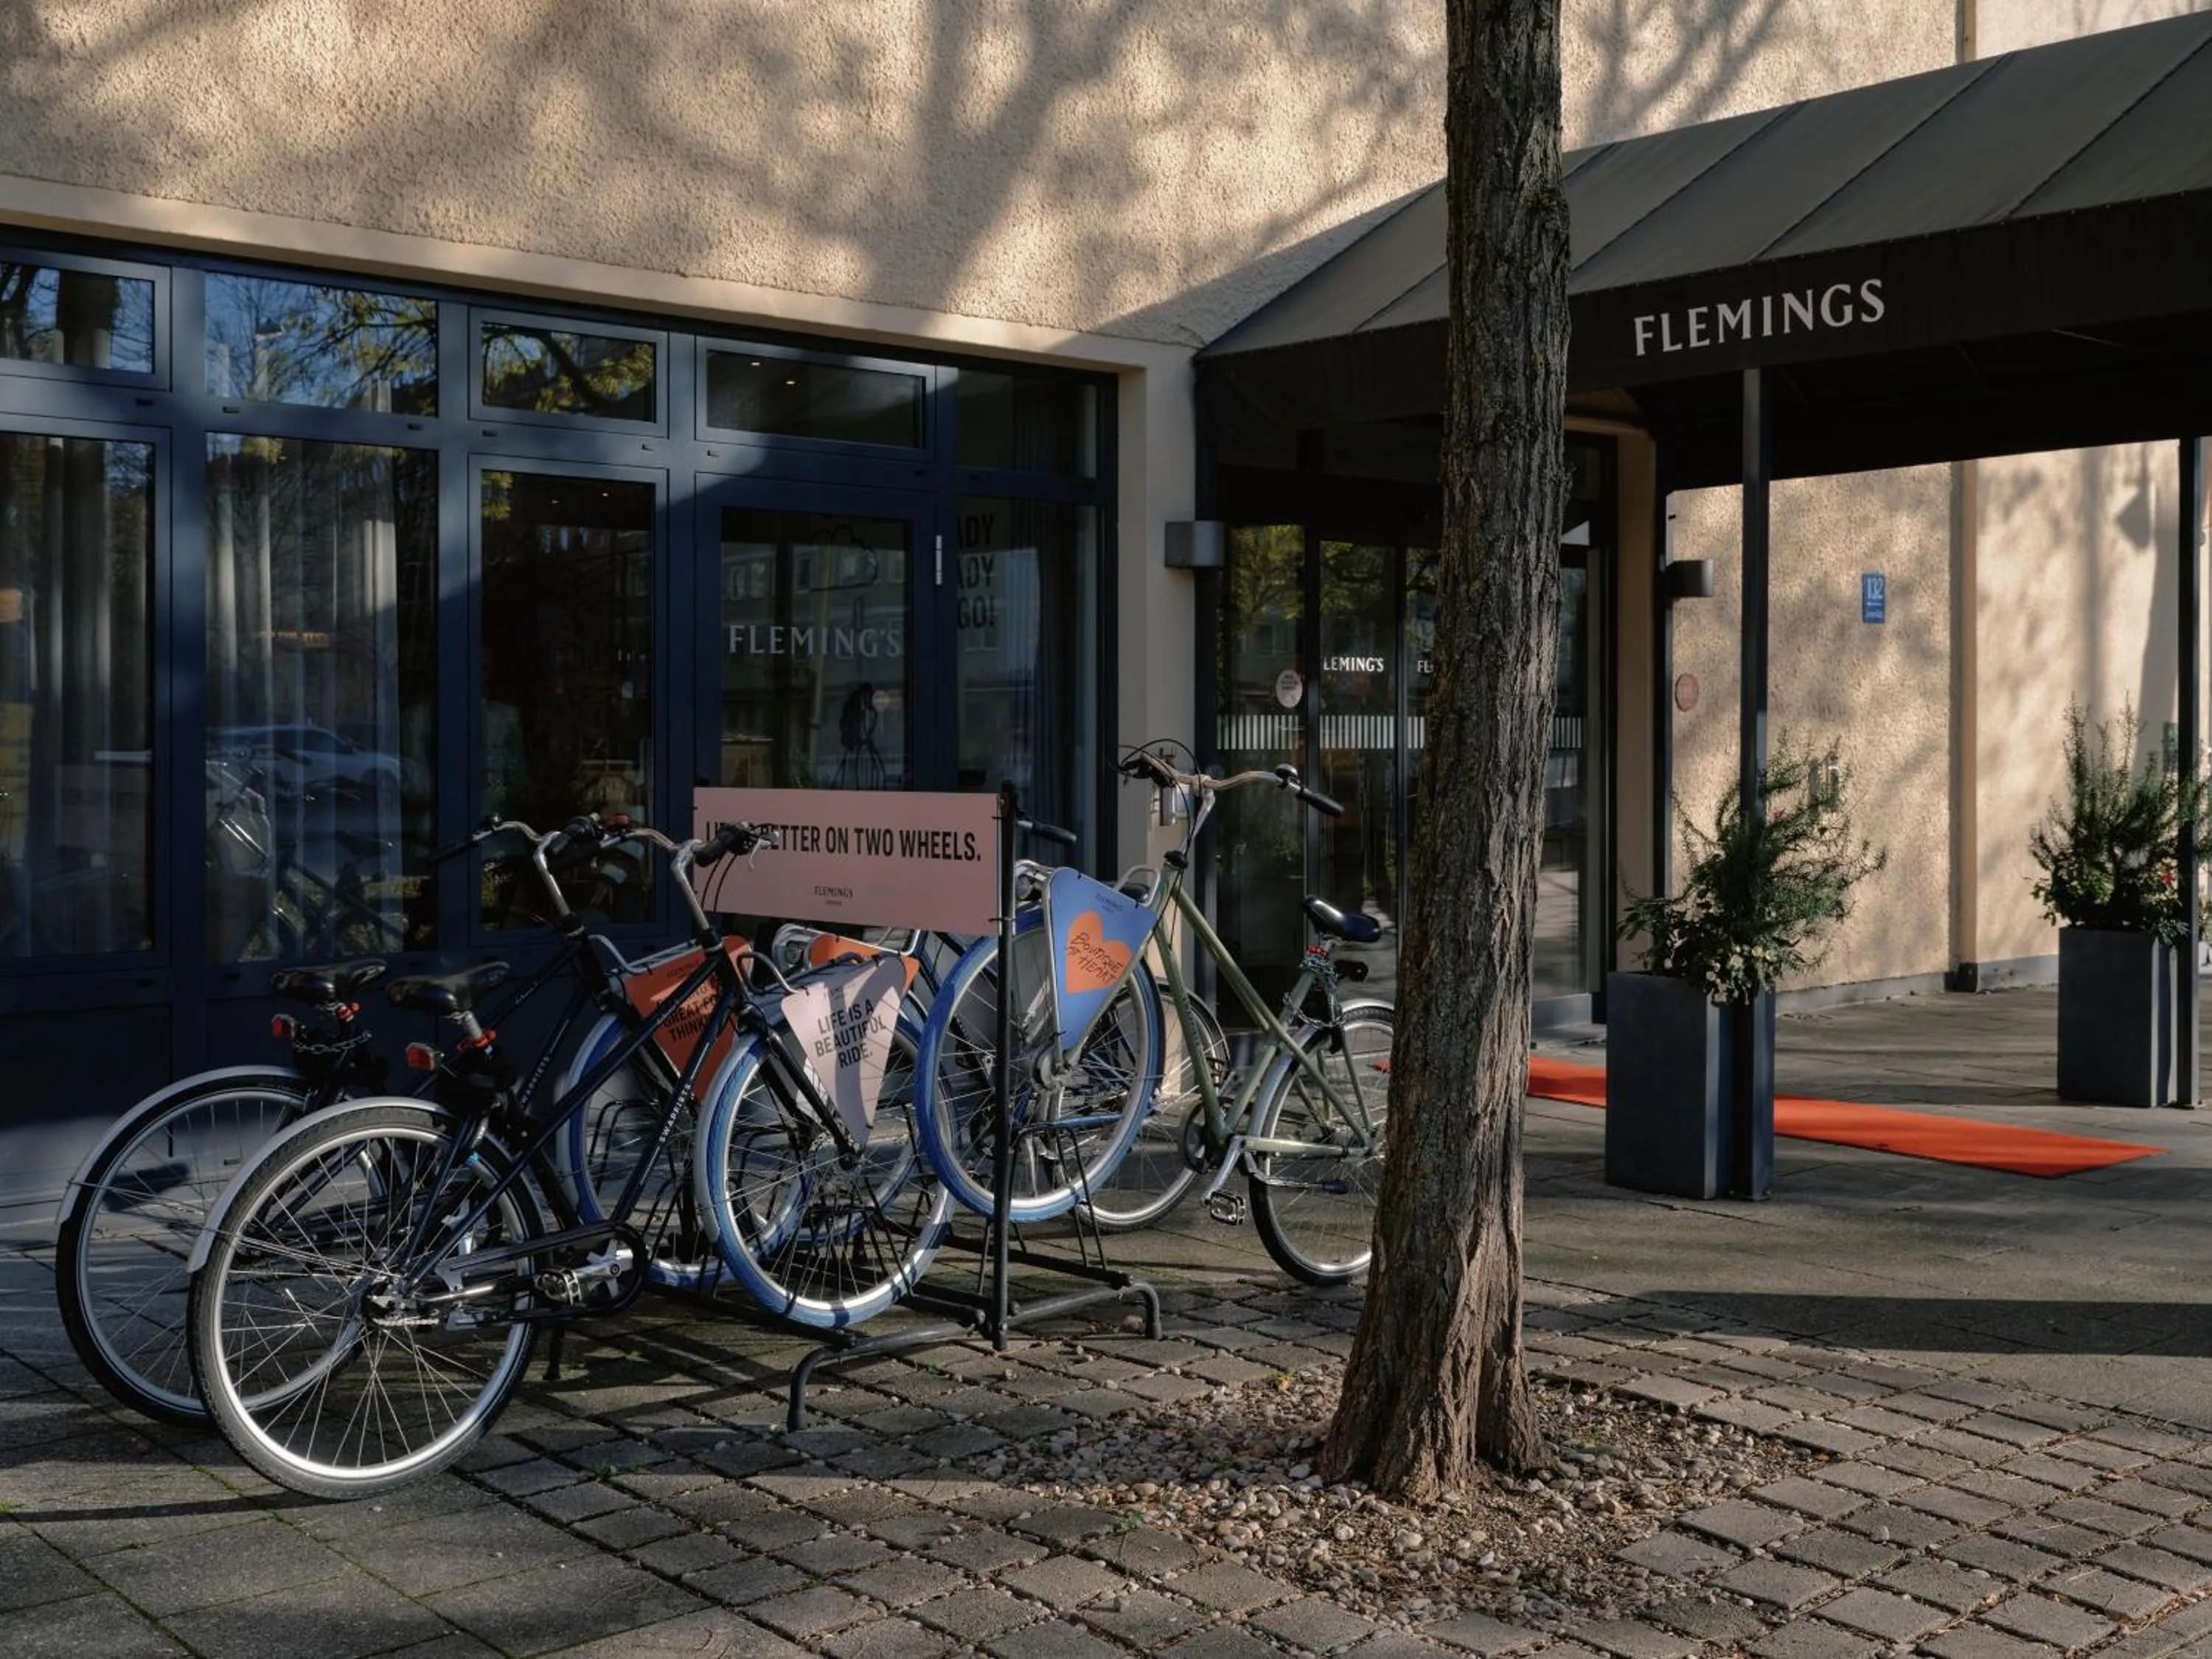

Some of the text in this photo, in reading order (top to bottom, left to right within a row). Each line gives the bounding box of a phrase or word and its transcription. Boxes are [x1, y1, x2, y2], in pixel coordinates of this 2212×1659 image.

[1634, 278, 1885, 356] FLEMINGS
[1323, 656, 1385, 673] LEMING'S
[826, 827, 849, 855] ON
[855, 828, 894, 857] TWO
[900, 830, 981, 862] WHEELS.
[818, 998, 874, 1034] LIFE IS A
[815, 1015, 887, 1058] BEAUTIFUL
[838, 1042, 874, 1069] RIDE.
